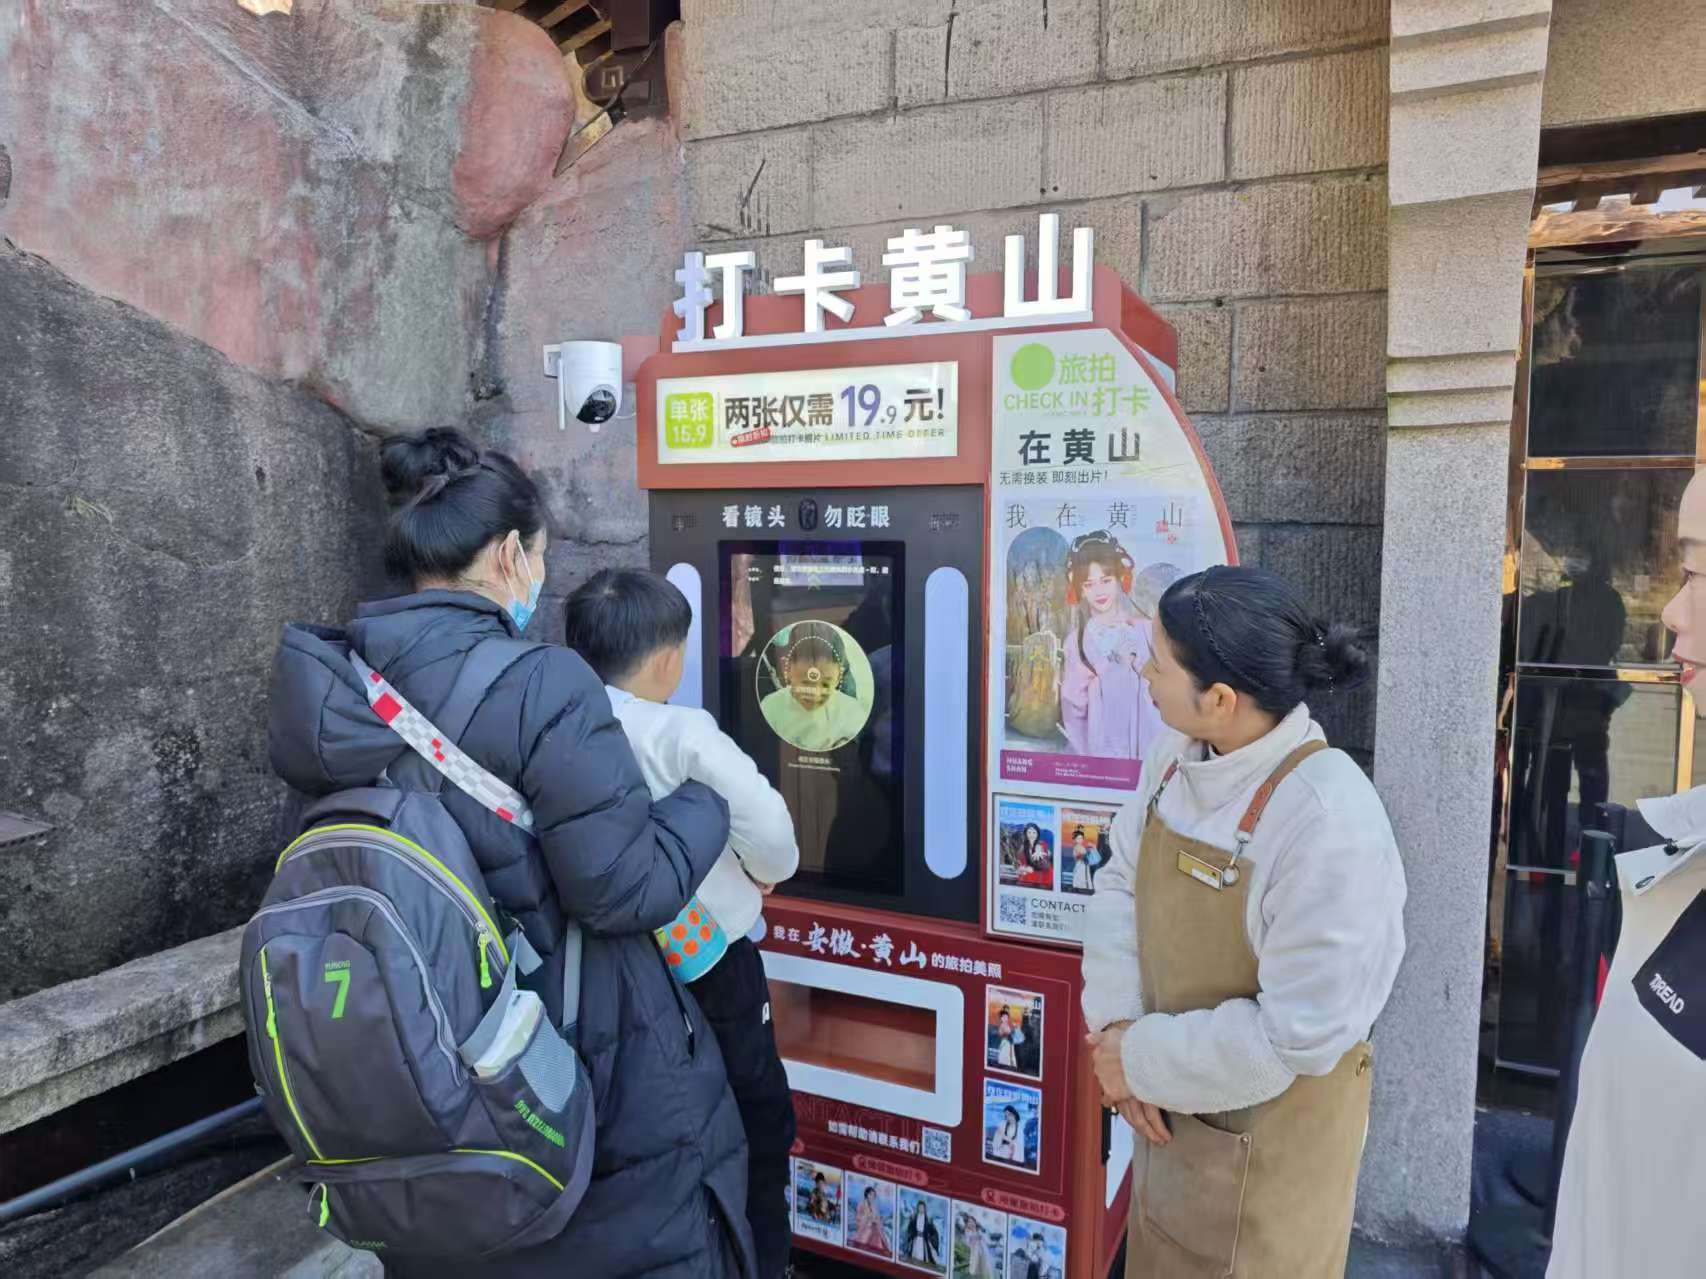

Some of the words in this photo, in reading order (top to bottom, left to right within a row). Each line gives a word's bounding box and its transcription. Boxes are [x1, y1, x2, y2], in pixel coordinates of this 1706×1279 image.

[672, 213, 1094, 341] 打卡黄山
[1058, 352, 1117, 384] 旅拍
[723, 392, 835, 429] 两张仅需
[840, 383, 897, 427] 19.9
[903, 387, 945, 423] 元!
[1003, 391, 1064, 411] CHECK
[1070, 391, 1089, 407] IN
[1092, 385, 1151, 416] 打卡
[825, 430, 871, 443] LIMITED
[875, 429, 904, 441] TIME
[907, 428, 945, 439] OFFER
[1018, 427, 1141, 465] 在黄山
[999, 471, 1048, 485] 无需换装
[721, 504, 786, 529] 看镜头
[824, 504, 891, 529] 勿眨眼
[1005, 501, 1183, 529] 我在黄山
[1006, 757, 1033, 766] HUANG
[1006, 764, 1028, 773] SHAN
[1030, 898, 1087, 913] CONTACT
[324, 969, 351, 1019] 7
